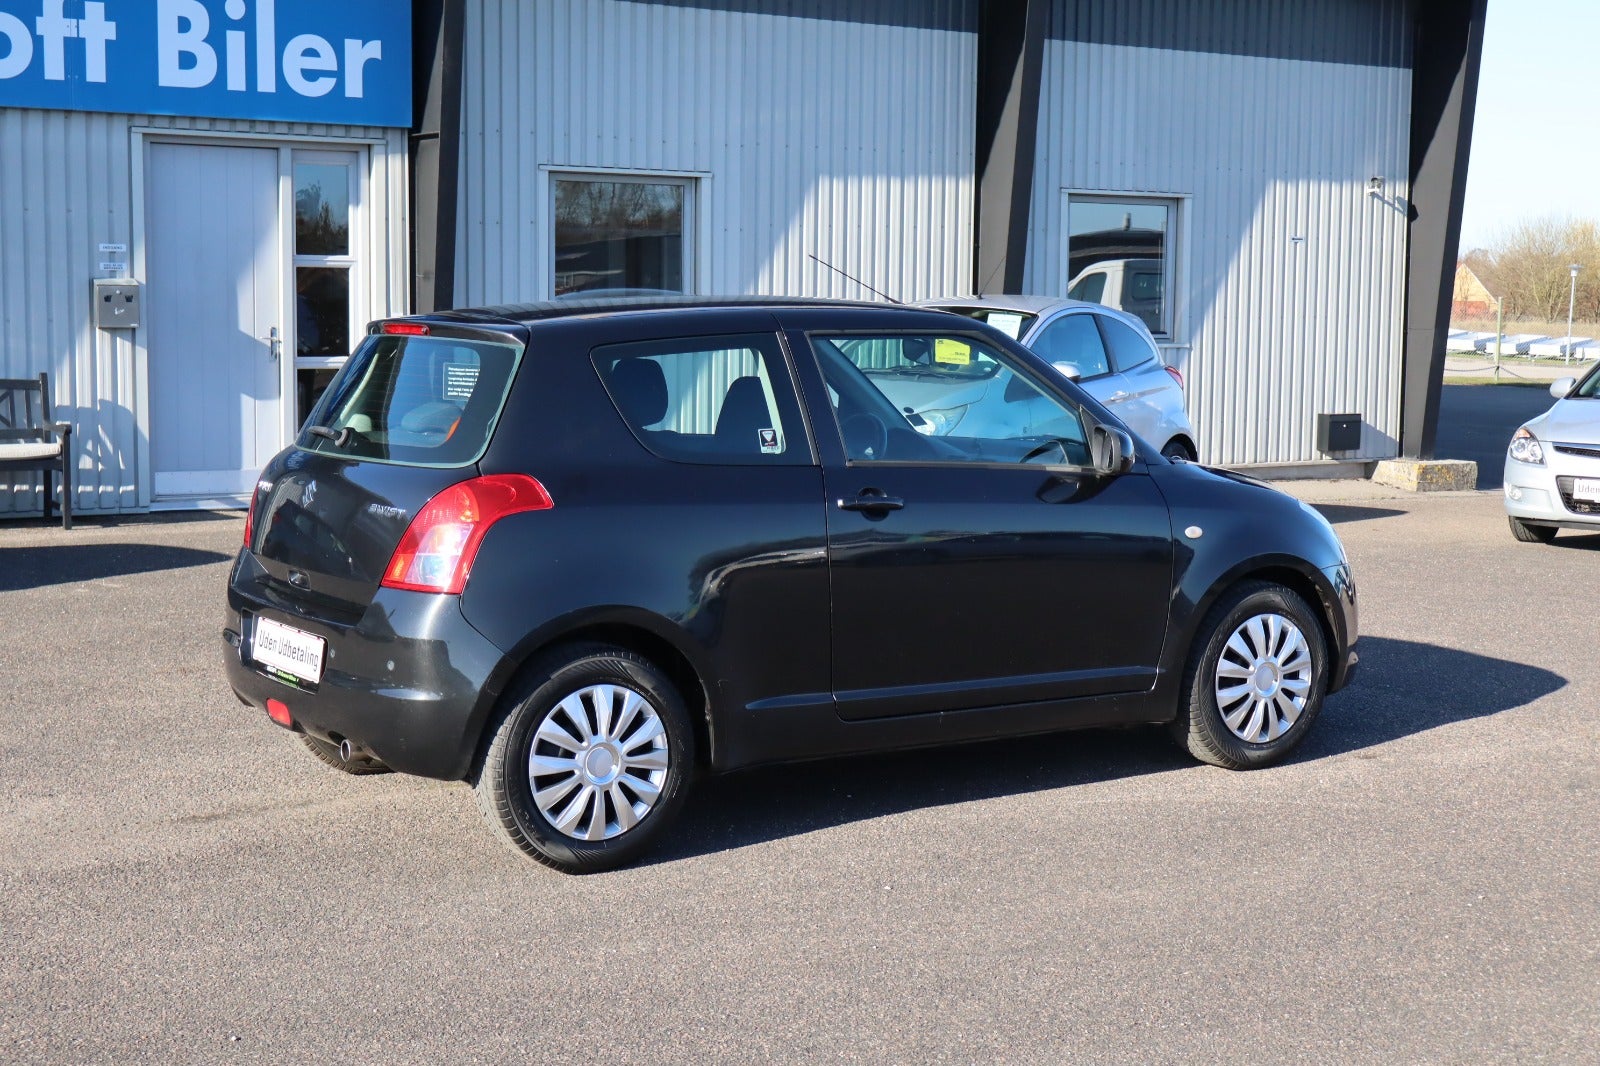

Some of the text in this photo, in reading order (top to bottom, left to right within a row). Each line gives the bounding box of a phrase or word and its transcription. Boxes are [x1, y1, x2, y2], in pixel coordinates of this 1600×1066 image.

[157, 0, 382, 98] Biler
[259, 629, 319, 672] Uden Udbetaling
